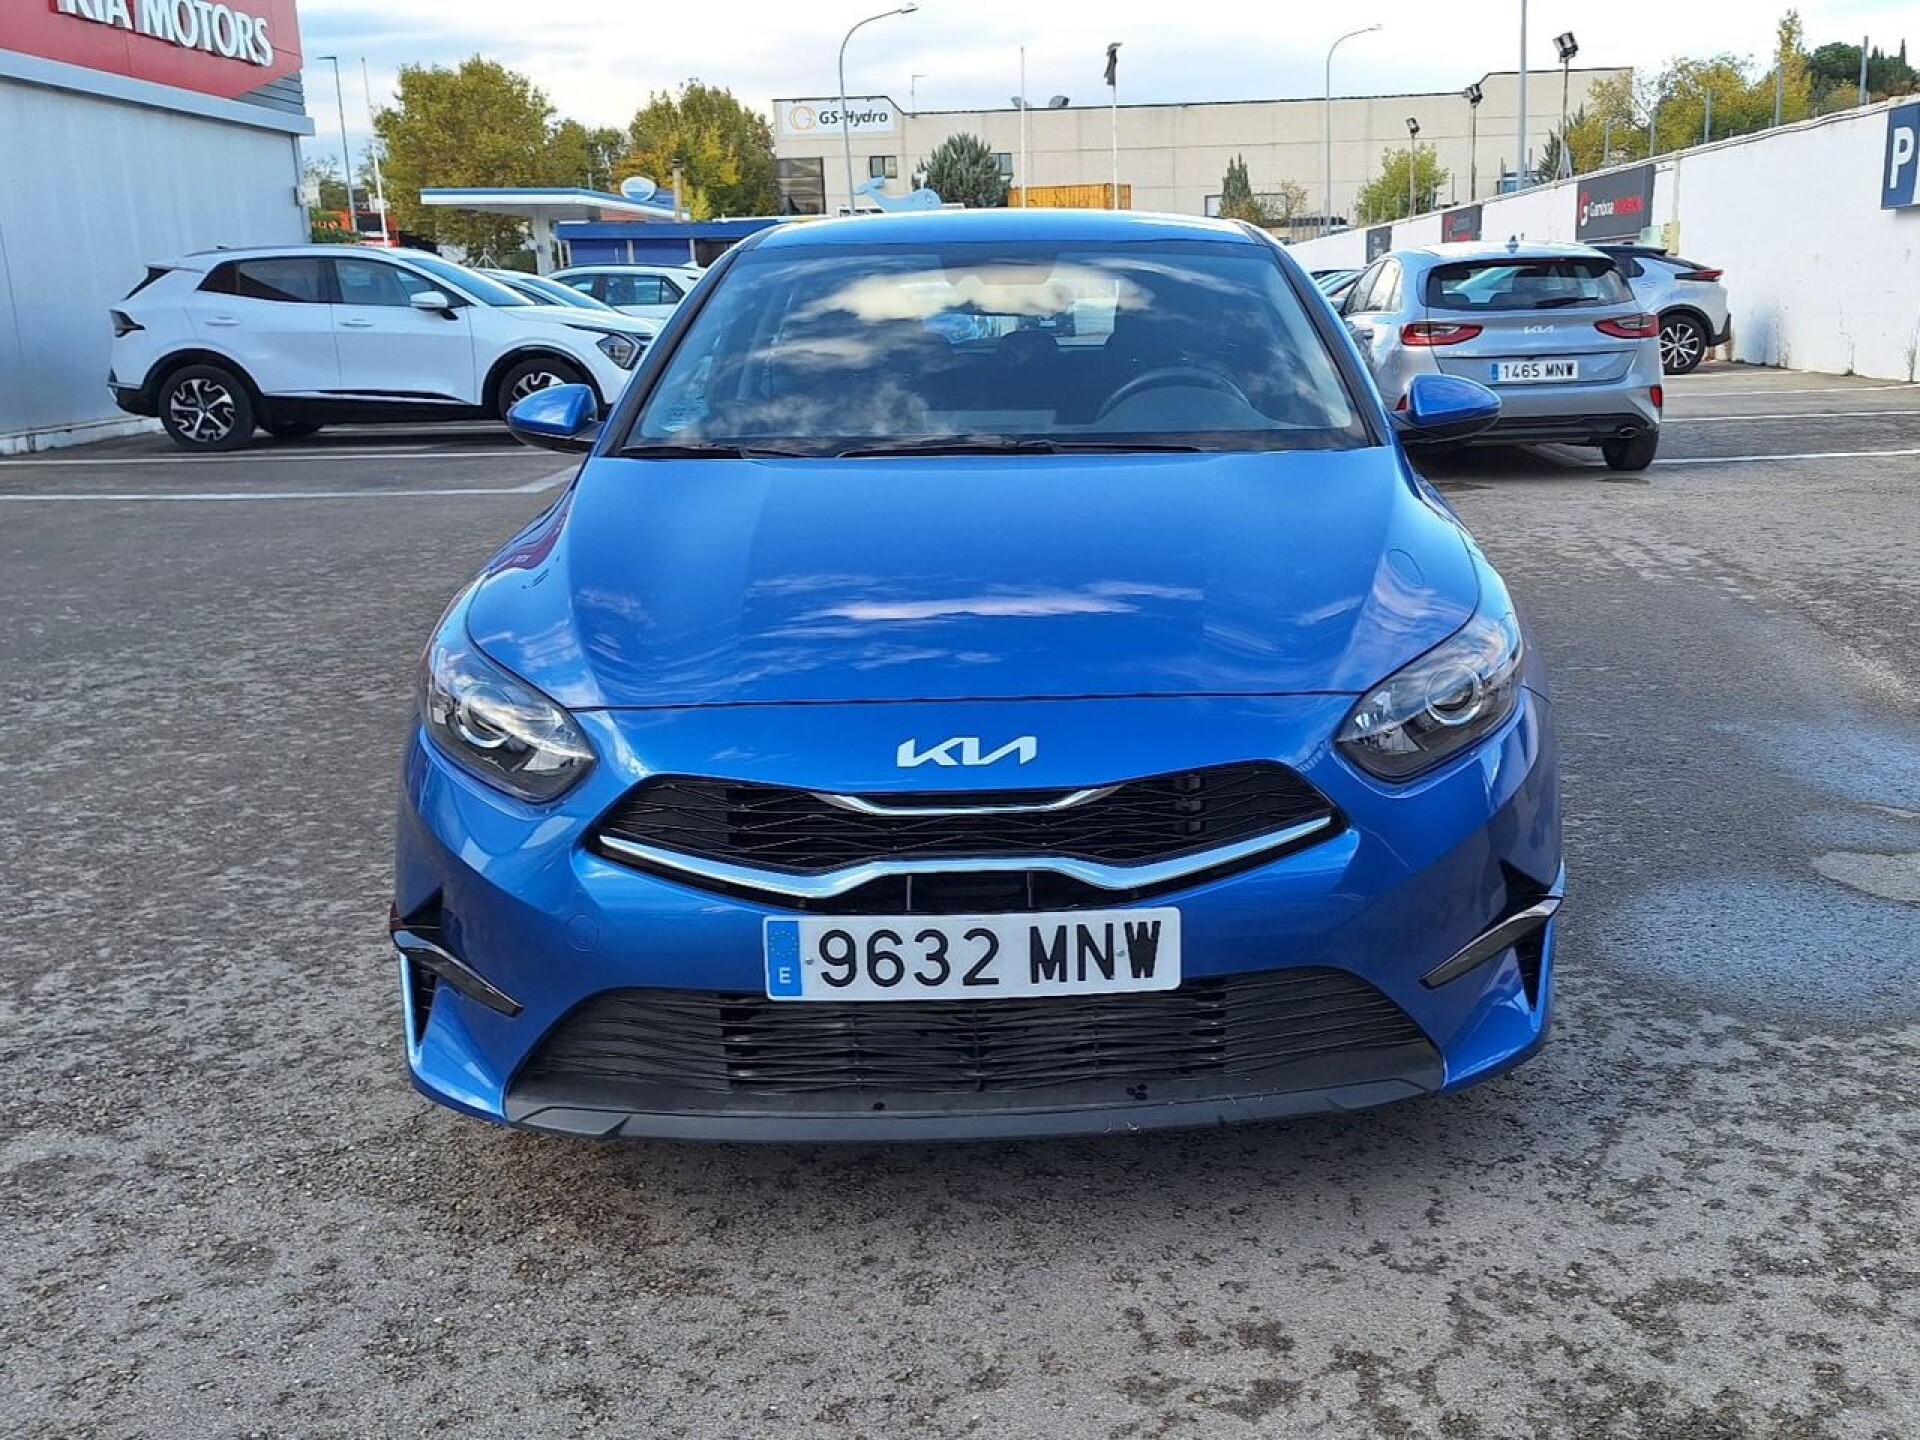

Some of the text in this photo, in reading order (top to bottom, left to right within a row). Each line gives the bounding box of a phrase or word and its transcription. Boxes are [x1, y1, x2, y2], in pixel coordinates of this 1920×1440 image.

[139, 0, 273, 67] MOTORS
[819, 109, 889, 127] GS-Hydro
[1889, 126, 1915, 190] P
[1503, 362, 1540, 379] 1465
[1544, 362, 1575, 378] MNW
[896, 735, 1038, 768] KIA
[818, 920, 1162, 988] 9632 MNW
[779, 967, 792, 985] E
